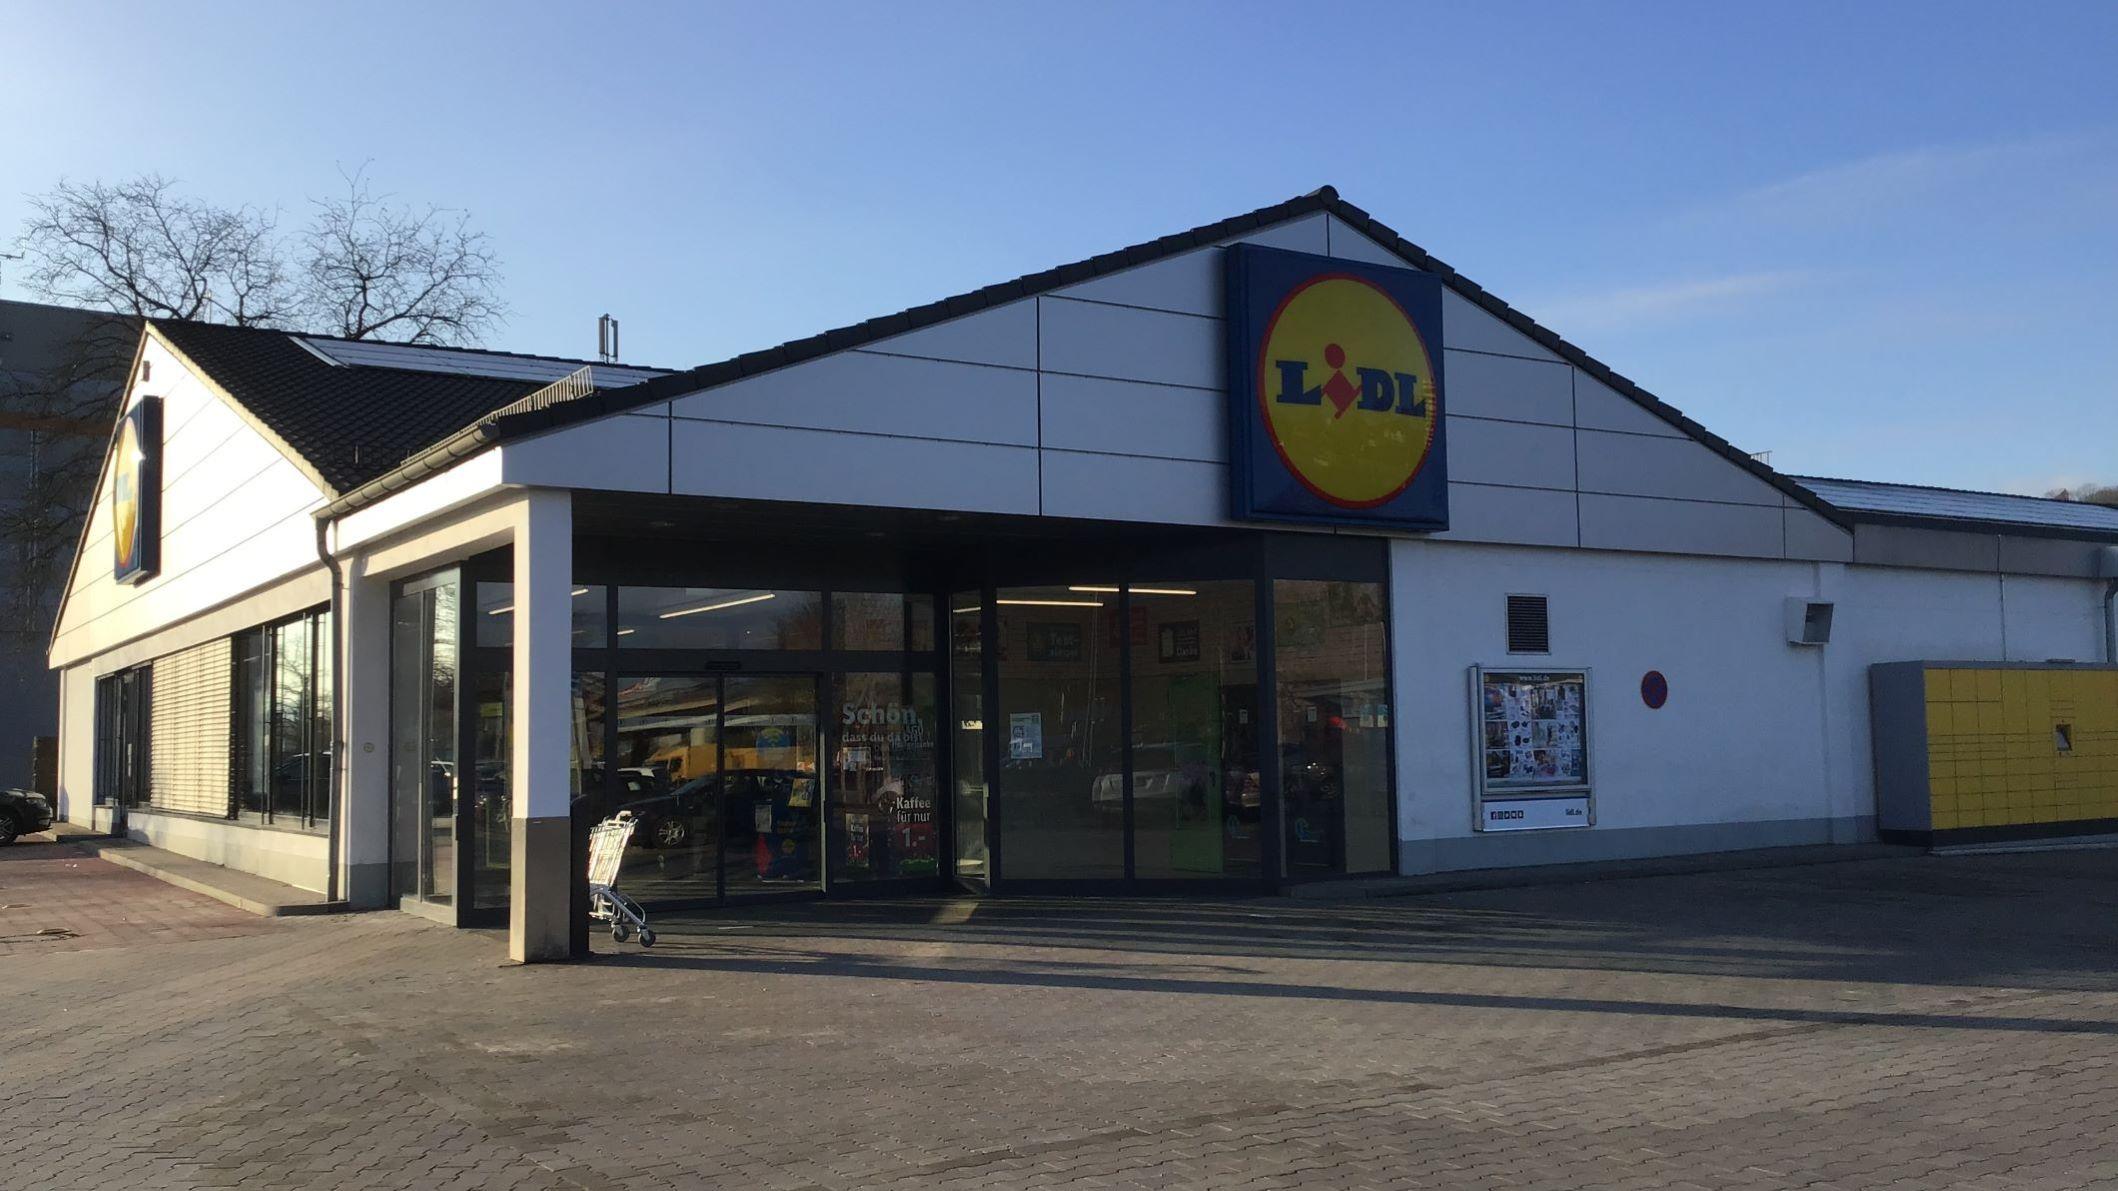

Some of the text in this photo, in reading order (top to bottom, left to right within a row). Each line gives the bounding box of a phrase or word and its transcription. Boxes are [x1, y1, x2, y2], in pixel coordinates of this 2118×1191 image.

[869, 732, 885, 743] du
[896, 796, 931, 809] Kaffee
[897, 809, 931, 823] für nur
[1565, 808, 1583, 816] lidl.de
